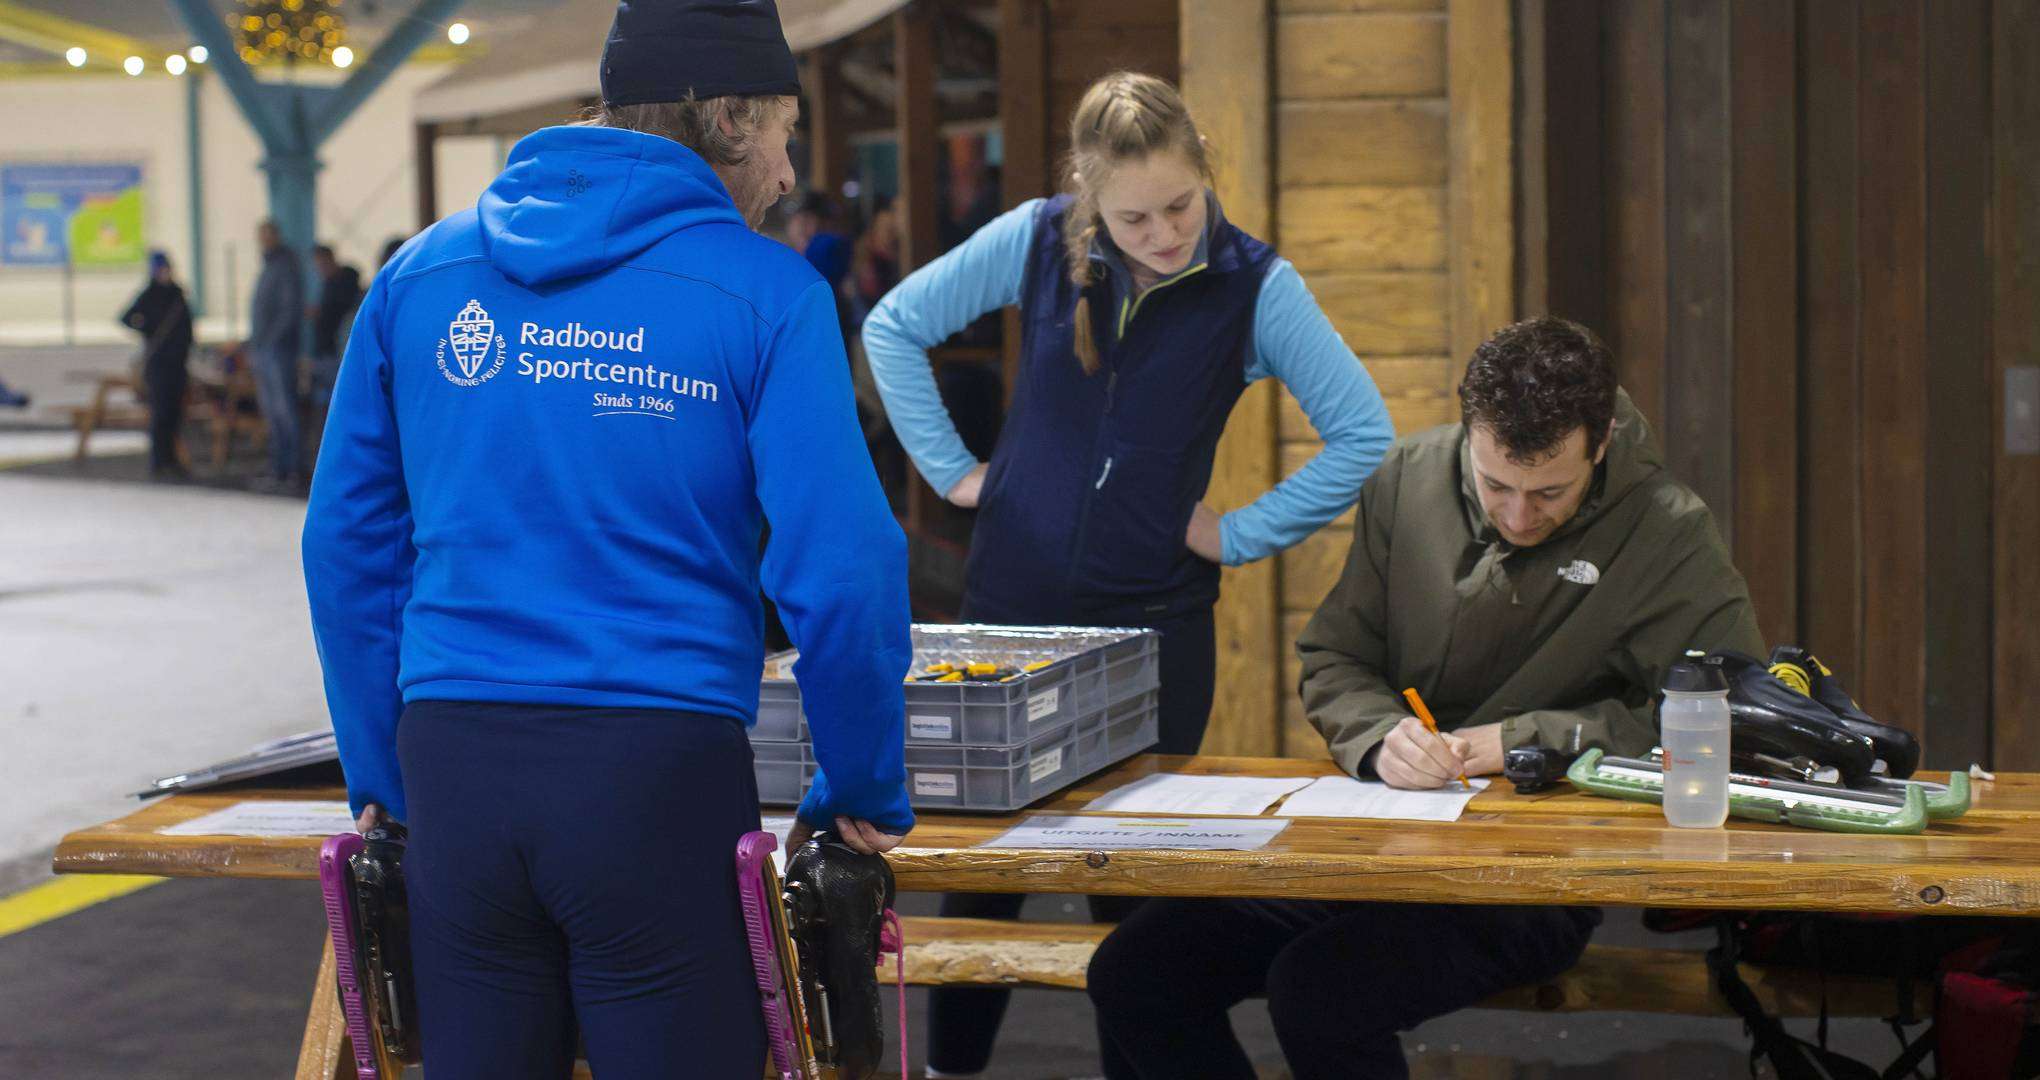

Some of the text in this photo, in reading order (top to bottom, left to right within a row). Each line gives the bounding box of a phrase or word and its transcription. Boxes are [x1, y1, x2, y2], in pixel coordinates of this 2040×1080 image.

[519, 321, 645, 353] Radboud
[516, 352, 719, 402] Sportcentrum
[592, 392, 676, 413] Sinds 1966
[1041, 829, 1132, 837] UITGIFTE
